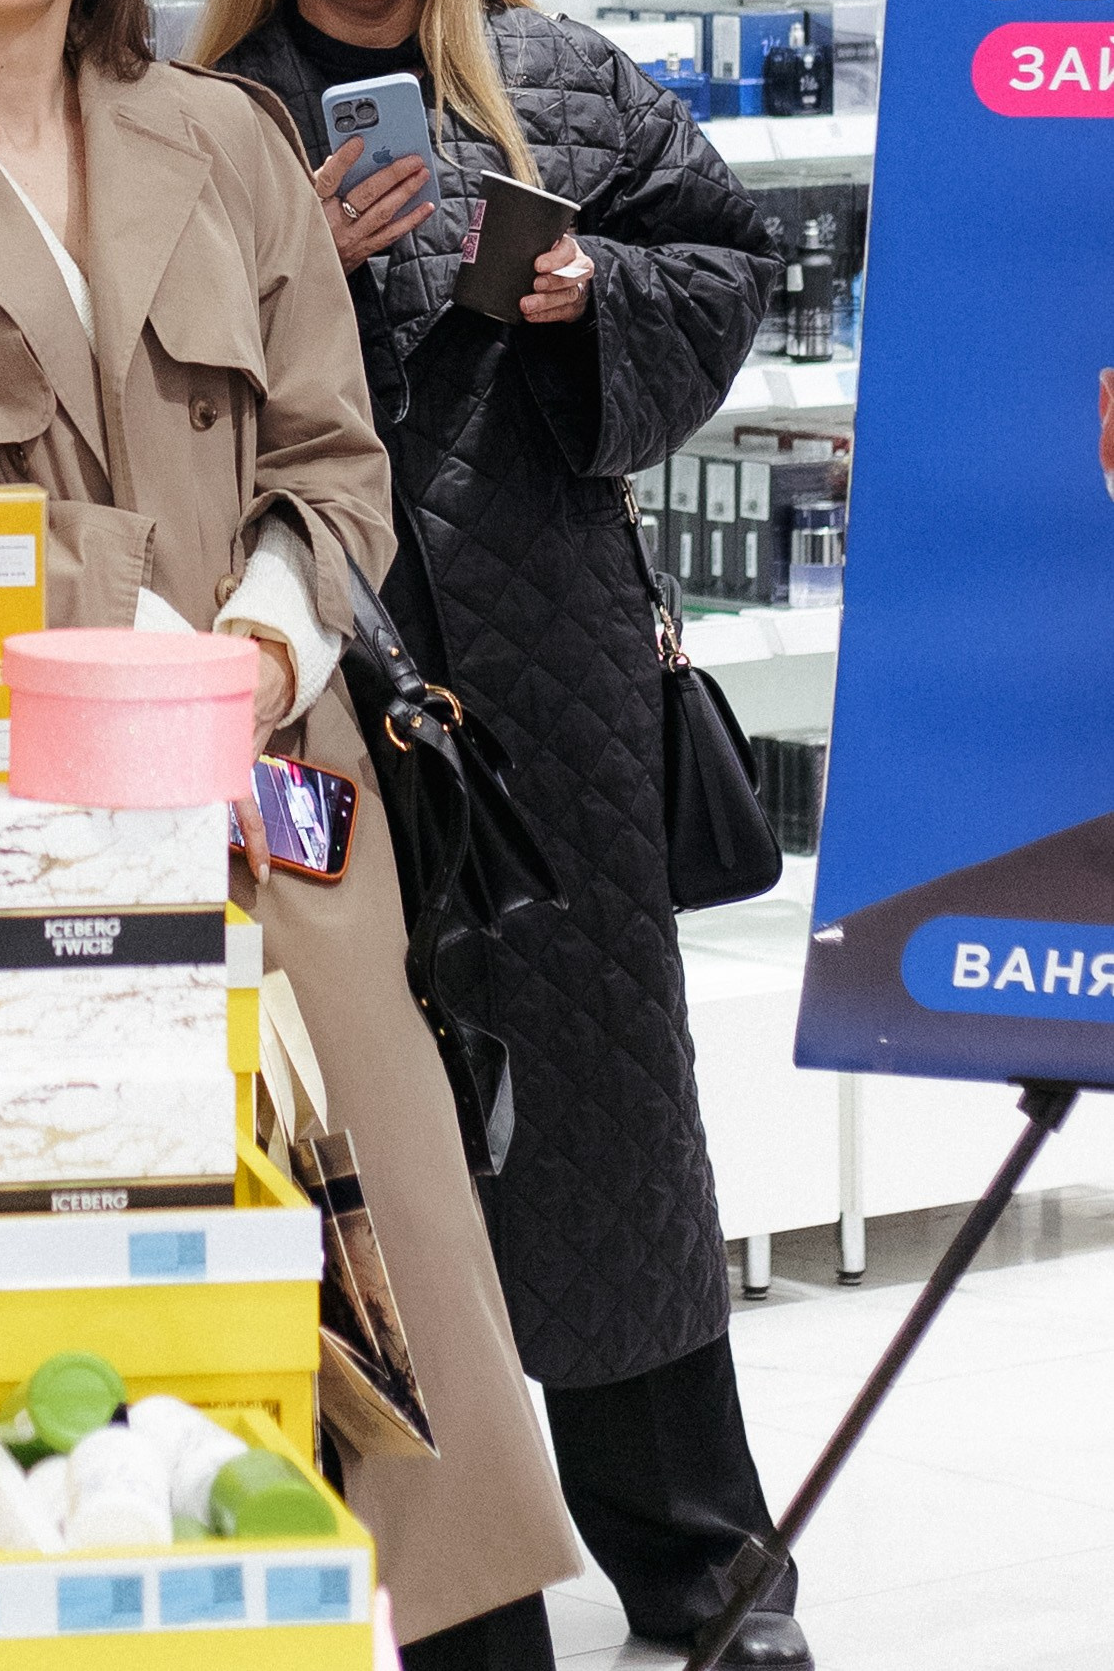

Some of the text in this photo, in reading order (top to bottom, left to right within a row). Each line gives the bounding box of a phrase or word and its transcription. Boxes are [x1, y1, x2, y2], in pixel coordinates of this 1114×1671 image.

[44, 917, 121, 939] ICEBERG
[51, 937, 114, 956] TWICE
[952, 942, 1114, 998] ВАНЯ
[50, 1189, 129, 1212] ICEBERG
